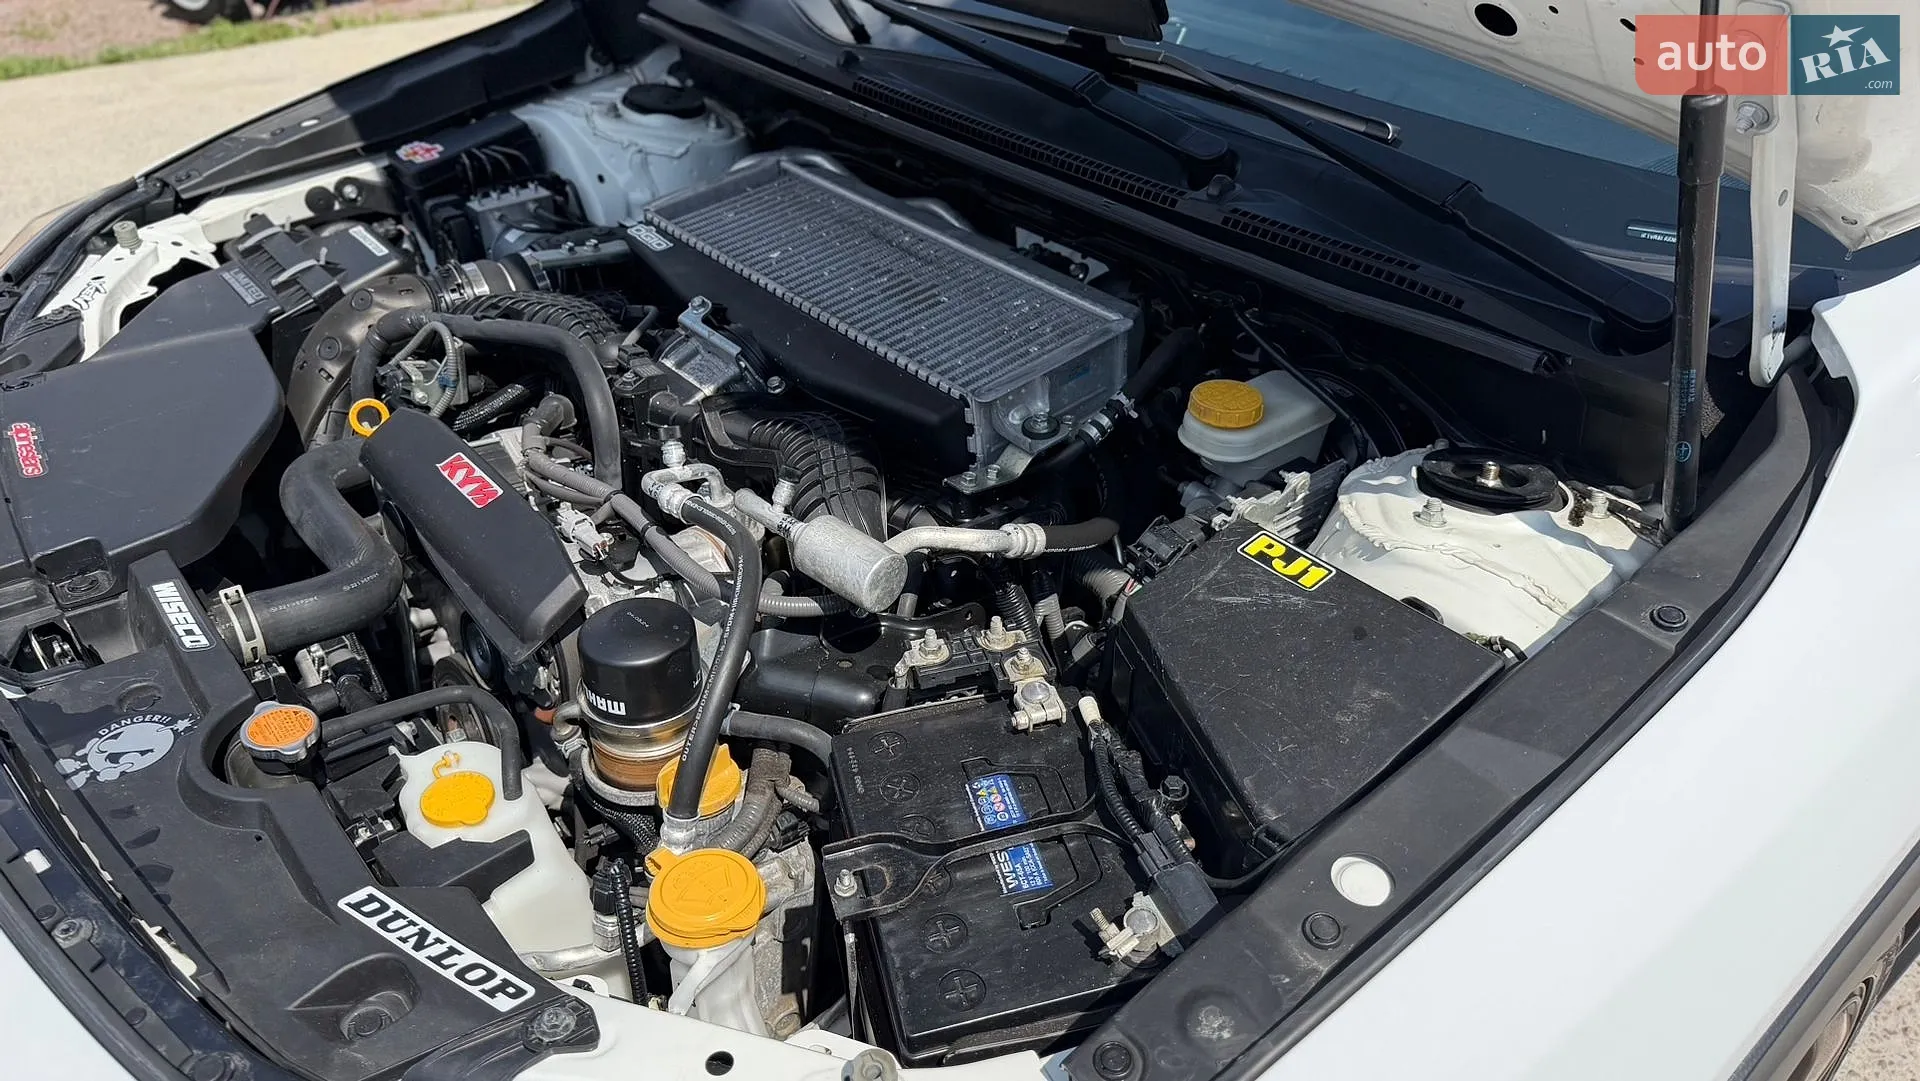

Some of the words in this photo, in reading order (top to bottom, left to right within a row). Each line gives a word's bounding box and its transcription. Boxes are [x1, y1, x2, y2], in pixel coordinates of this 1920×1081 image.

[229, 268, 267, 300] LIMITED
[439, 454, 500, 506] KYB
[1244, 535, 1328, 587] PJ1
[152, 581, 210, 649] WISECO
[98, 715, 171, 735] DANGER!!
[997, 850, 1018, 889] WES
[345, 893, 527, 1001] DUNLOP
